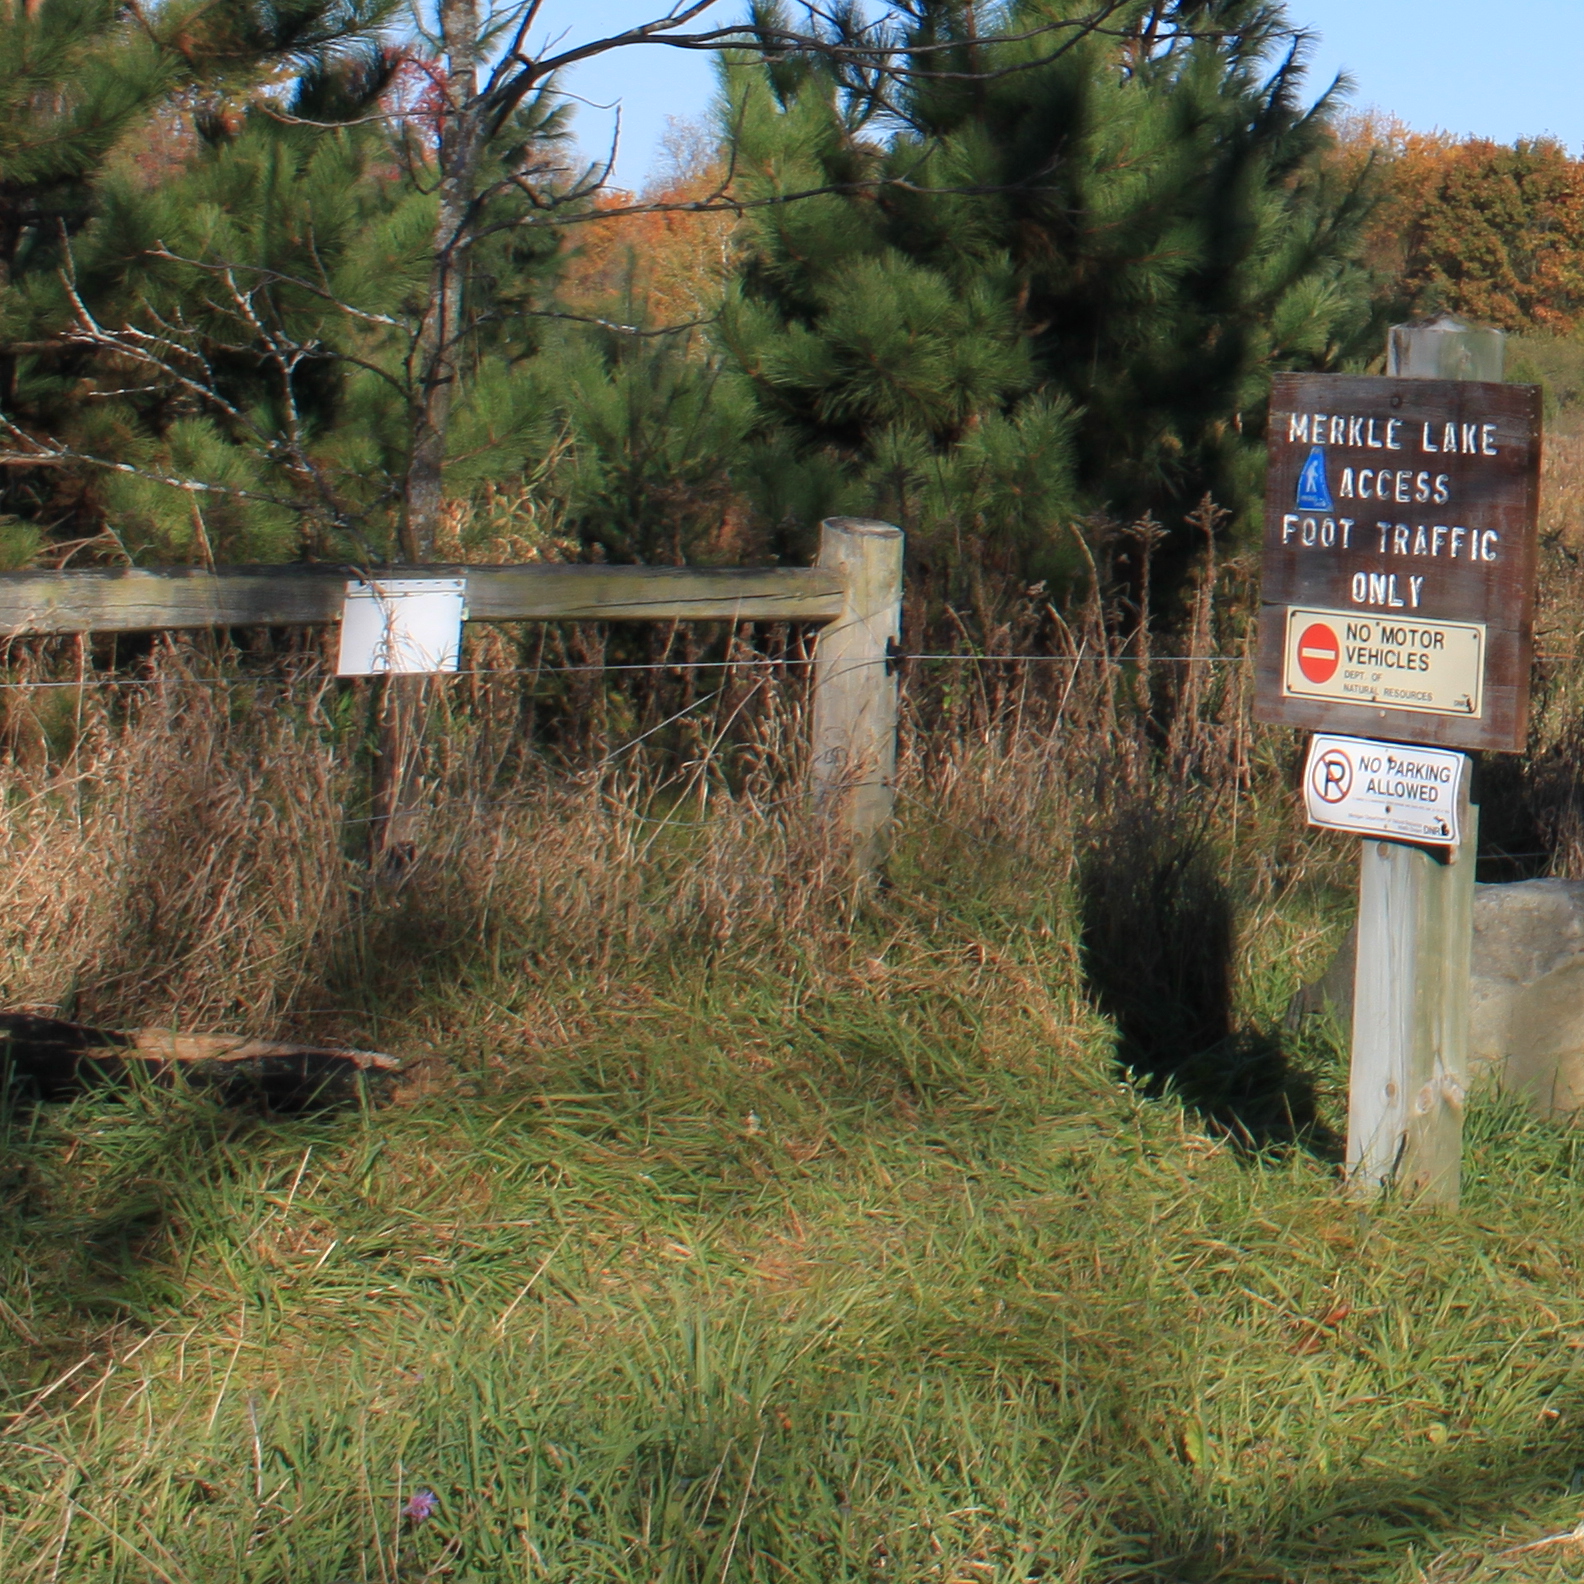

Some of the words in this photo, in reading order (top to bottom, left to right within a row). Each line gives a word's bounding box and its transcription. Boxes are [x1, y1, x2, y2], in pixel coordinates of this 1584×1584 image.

[1288, 412, 1403, 450] MERKLE
[1423, 421, 1497, 456] LAKE
[1339, 467, 1450, 505] ACCESS
[1282, 513, 1355, 550] FOOT
[1376, 521, 1499, 562] TRAFFIC
[1351, 571, 1425, 608] ONLY
[1346, 622, 1371, 643] NO
[1380, 625, 1446, 650] MOTOR
[1345, 645, 1430, 672] VEHICLES
[1371, 672, 1383, 682] OF
[1343, 683, 1380, 696] NATURAL
[1383, 687, 1434, 702] RESOURCES
[1358, 755, 1382, 774] NO
[1386, 757, 1452, 784] PARKING
[1366, 777, 1439, 803] ALLOWED
[1422, 824, 1441, 836] DNR
